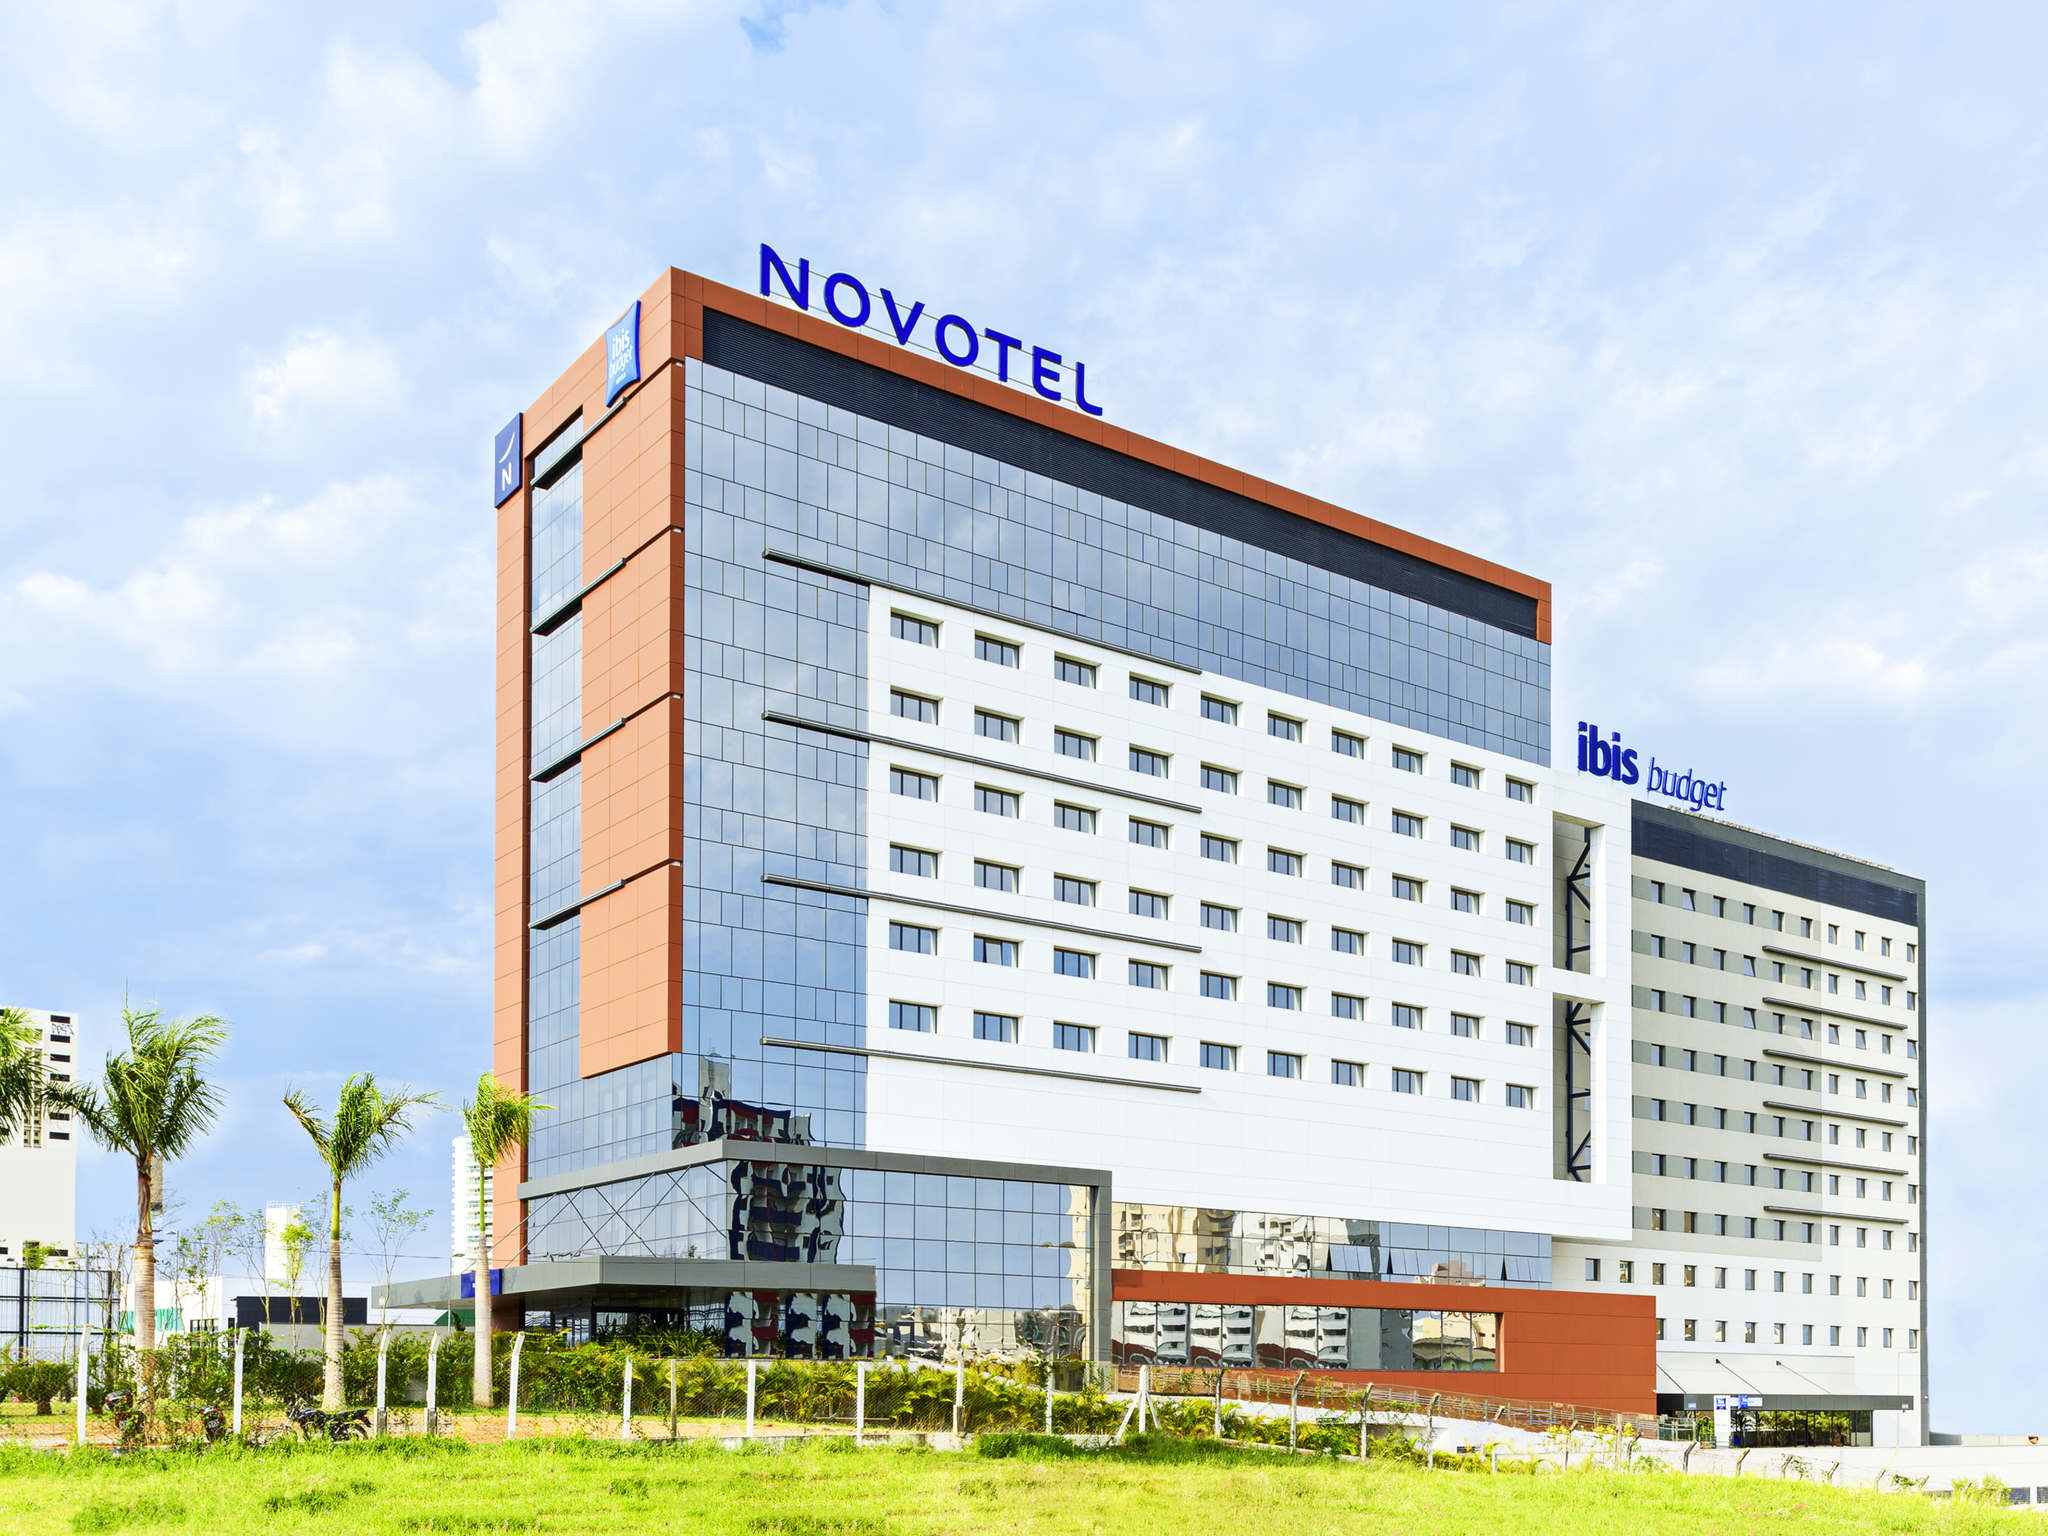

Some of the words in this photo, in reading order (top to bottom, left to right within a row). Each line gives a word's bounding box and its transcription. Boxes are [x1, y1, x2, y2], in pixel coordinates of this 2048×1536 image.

[760, 243, 1103, 416] NOVOTEL
[502, 462, 512, 491] N
[1578, 721, 1639, 785] ibis
[1647, 757, 1727, 812] budget
